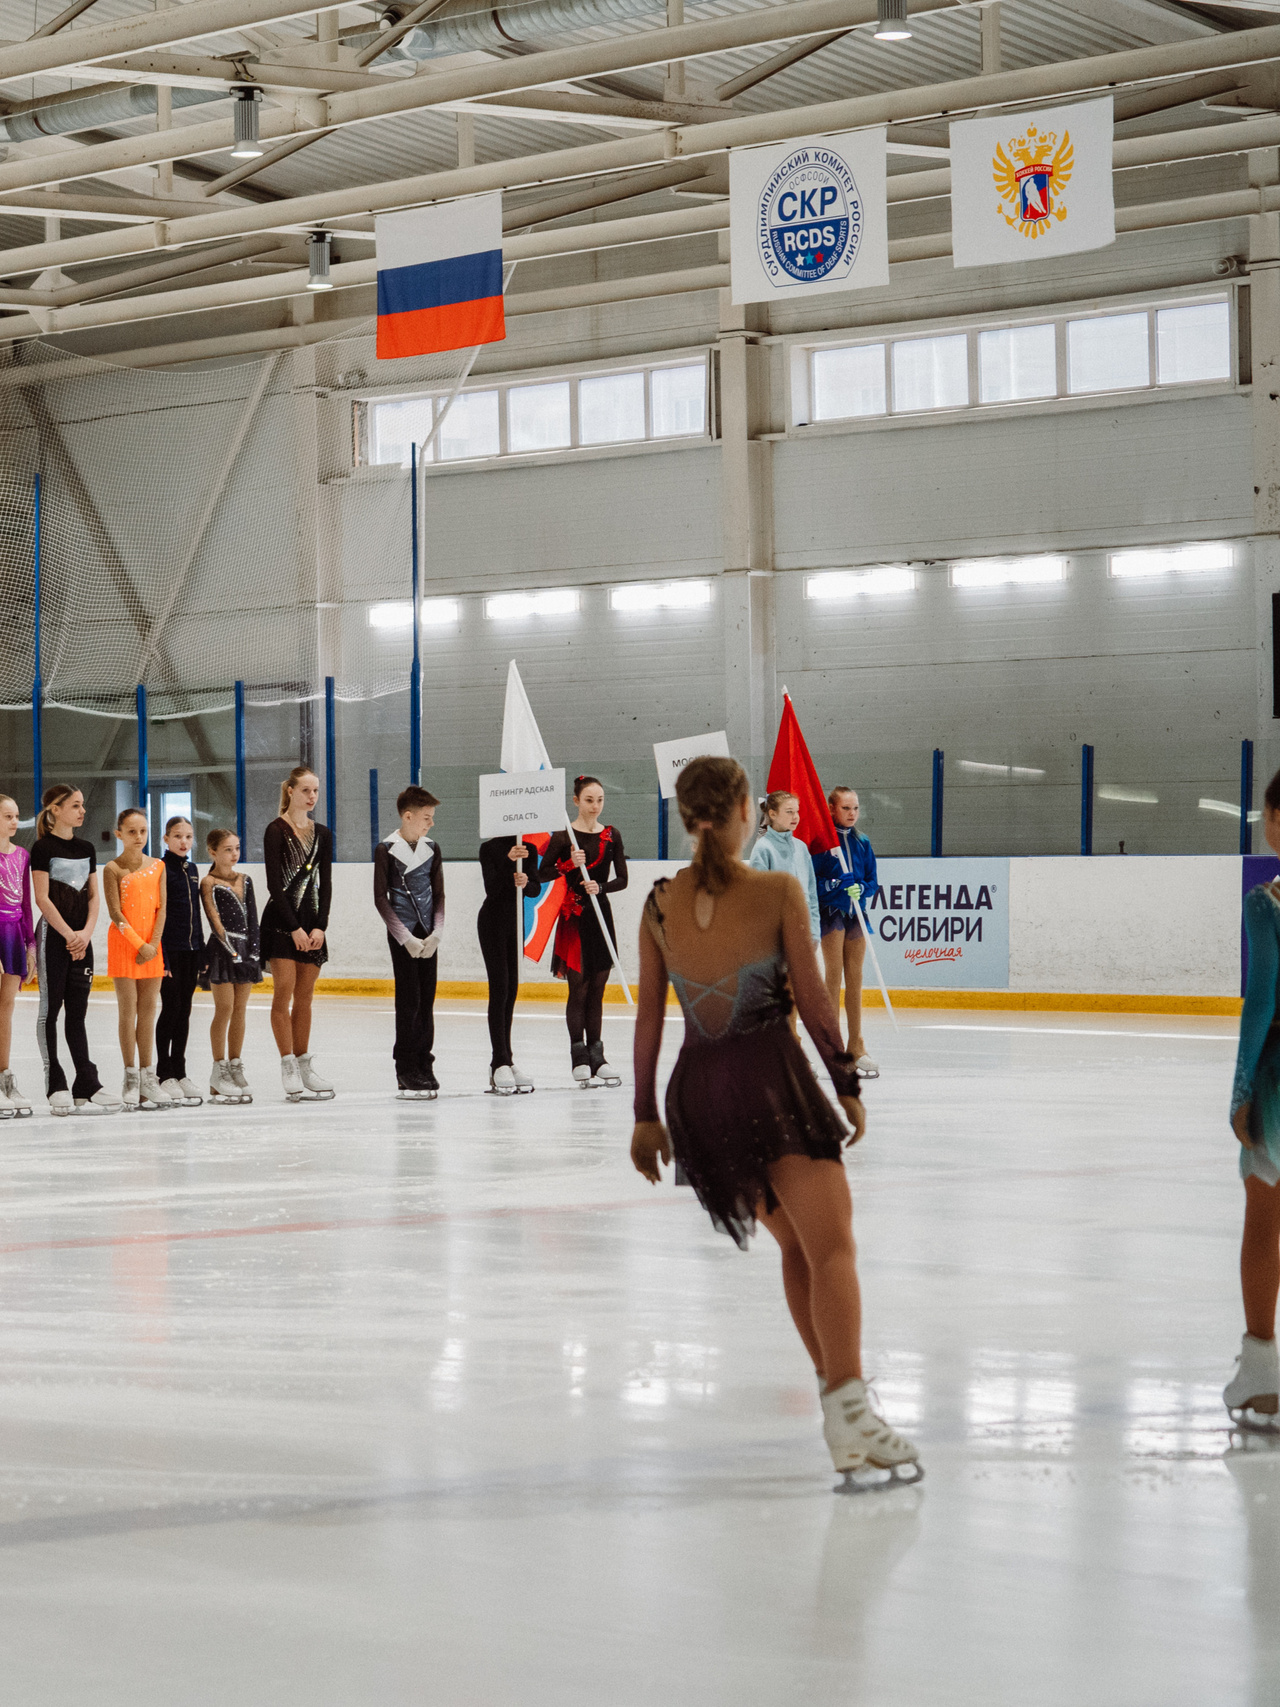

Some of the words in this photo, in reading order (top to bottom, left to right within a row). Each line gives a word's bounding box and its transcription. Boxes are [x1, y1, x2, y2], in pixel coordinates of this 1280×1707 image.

[778, 186, 838, 222] СКР
[814, 151, 855, 193] КОМИТЕТ
[843, 200, 861, 266] РОССИИ
[772, 230, 787, 263] RUSSIAN
[785, 260, 817, 279] COMMITTEE
[817, 264, 827, 276] OF
[825, 252, 839, 270] DEAF
[835, 220, 847, 253] SPORTS
[783, 226, 836, 252] RCDS
[489, 785, 555, 798] ЛЕНИНГРАДСКАЯ
[502, 812, 539, 822] ОБЛАСТЬ
[879, 915, 983, 942] СИБИРИ
[904, 946, 963, 963] щелочная
